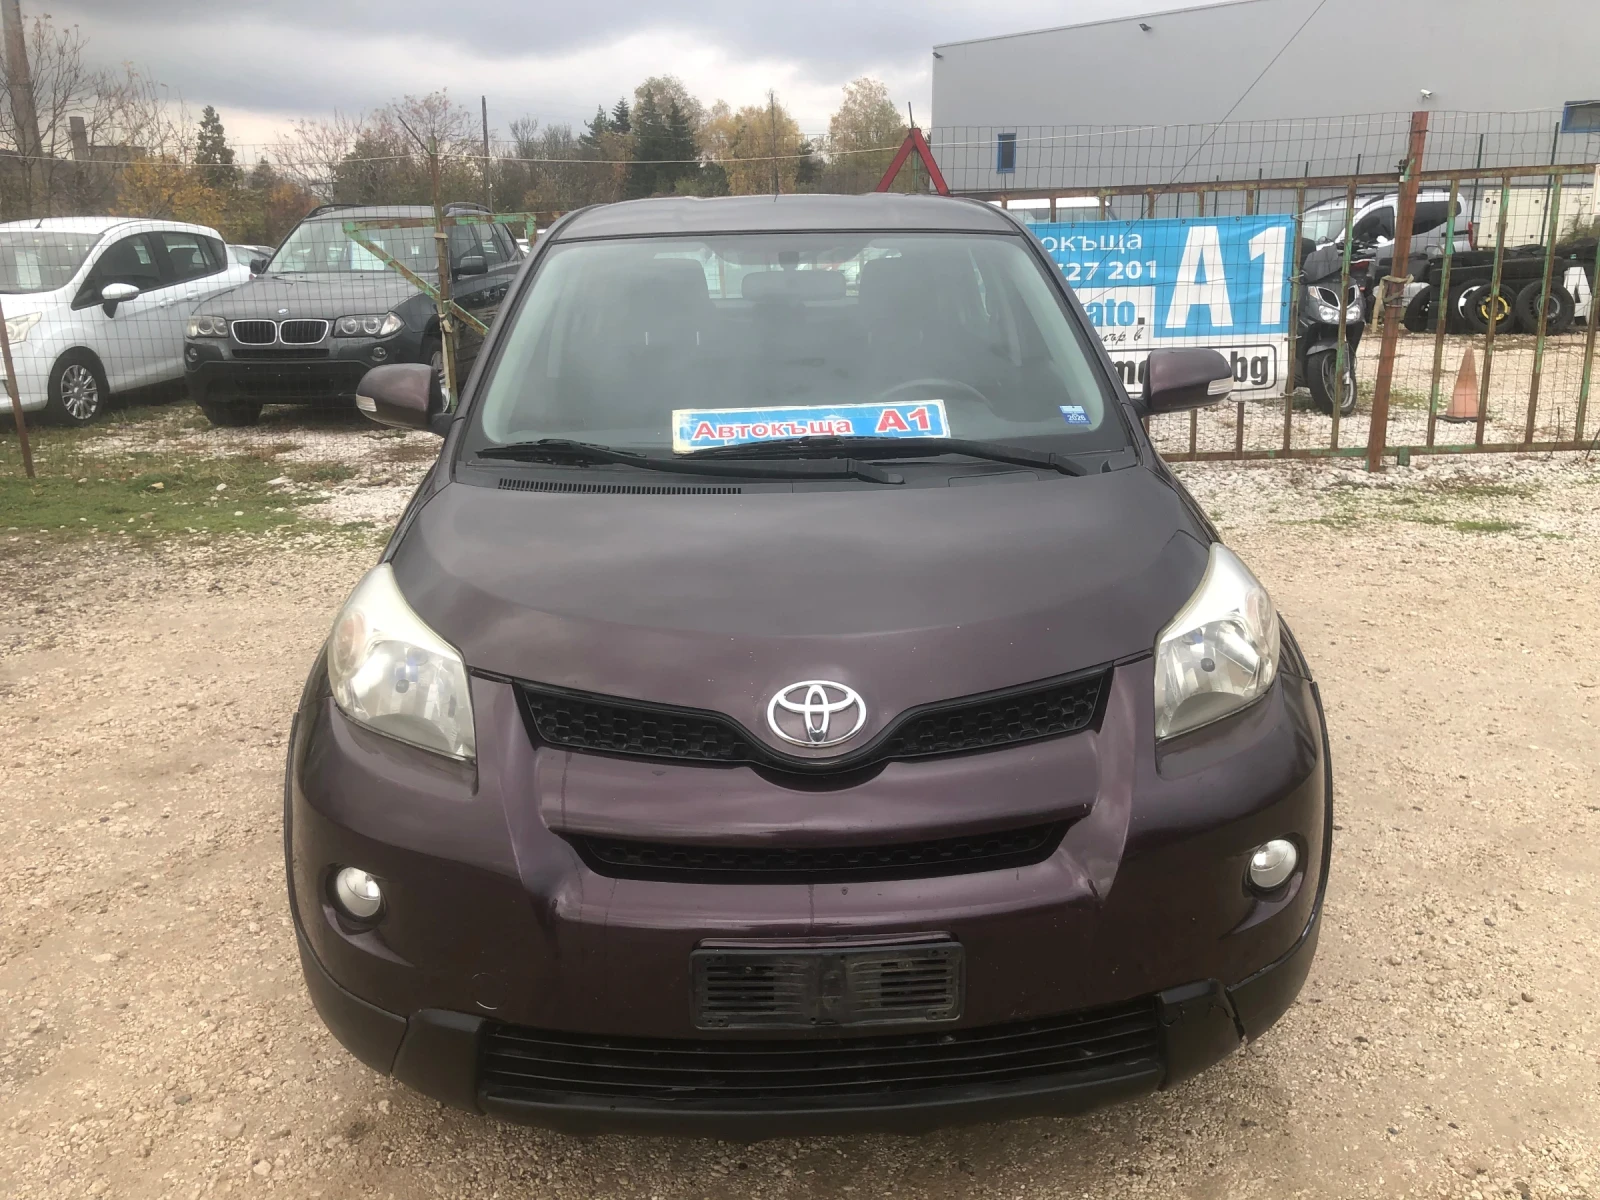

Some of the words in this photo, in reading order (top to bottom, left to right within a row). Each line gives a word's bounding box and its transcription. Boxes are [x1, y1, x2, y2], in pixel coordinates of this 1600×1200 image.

[1058, 262, 1100, 281] 27
[1107, 260, 1157, 280] 201
[1165, 225, 1287, 328] A1
[693, 421, 853, 439] Автокъща
